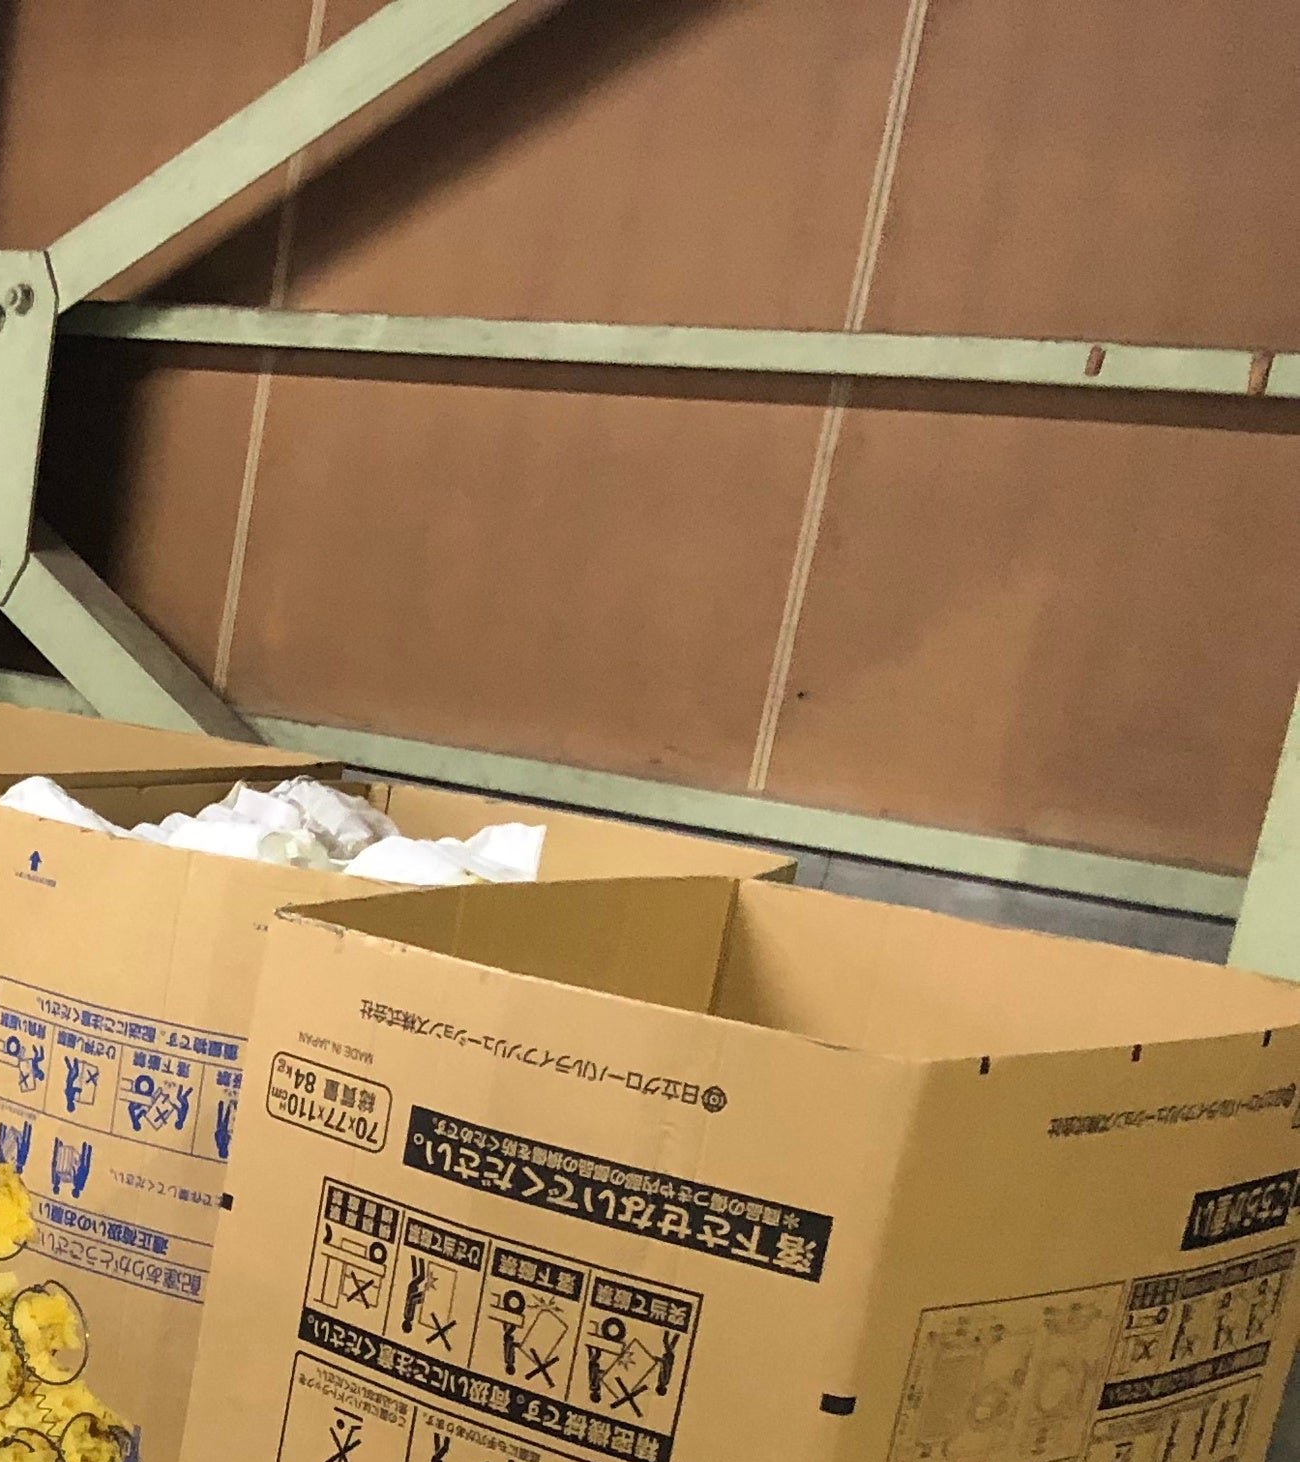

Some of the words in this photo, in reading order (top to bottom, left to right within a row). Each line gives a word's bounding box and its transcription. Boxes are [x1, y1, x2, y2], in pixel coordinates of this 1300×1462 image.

[297, 1031, 330, 1051] JAPAN
[331, 1042, 343, 1055] IN
[343, 1045, 375, 1064] MADE
[357, 998, 700, 1107] 日立グローバルライフソリューションズ株式会社
[38, 1202, 169, 1255] 適正荷扱いのお願い
[410, 1130, 819, 1274] 落下させないでください。
[304, 1314, 662, 1462] 精密機械です。荷扱いにご注意ください。
